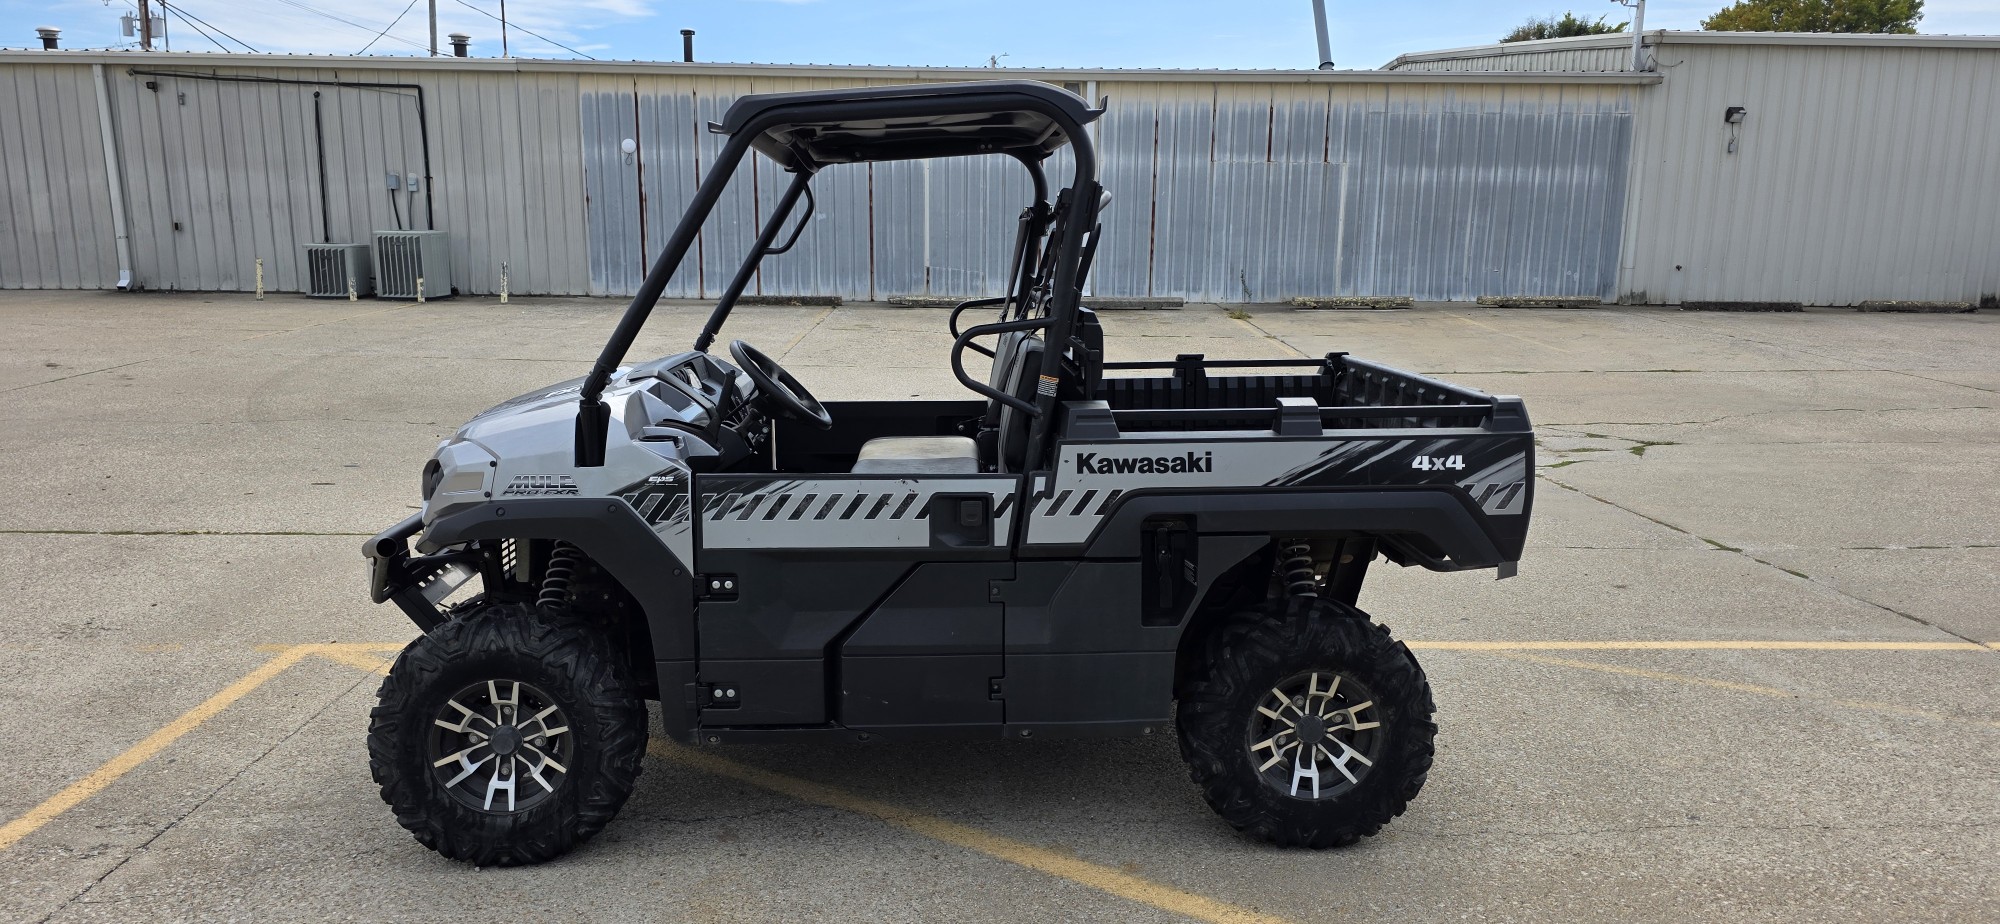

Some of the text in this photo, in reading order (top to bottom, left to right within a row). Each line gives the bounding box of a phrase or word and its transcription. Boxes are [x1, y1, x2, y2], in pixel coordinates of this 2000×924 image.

[1077, 452, 1212, 474] Kawasaki
[1411, 455, 1466, 471] 4x4
[506, 474, 578, 489] MULE
